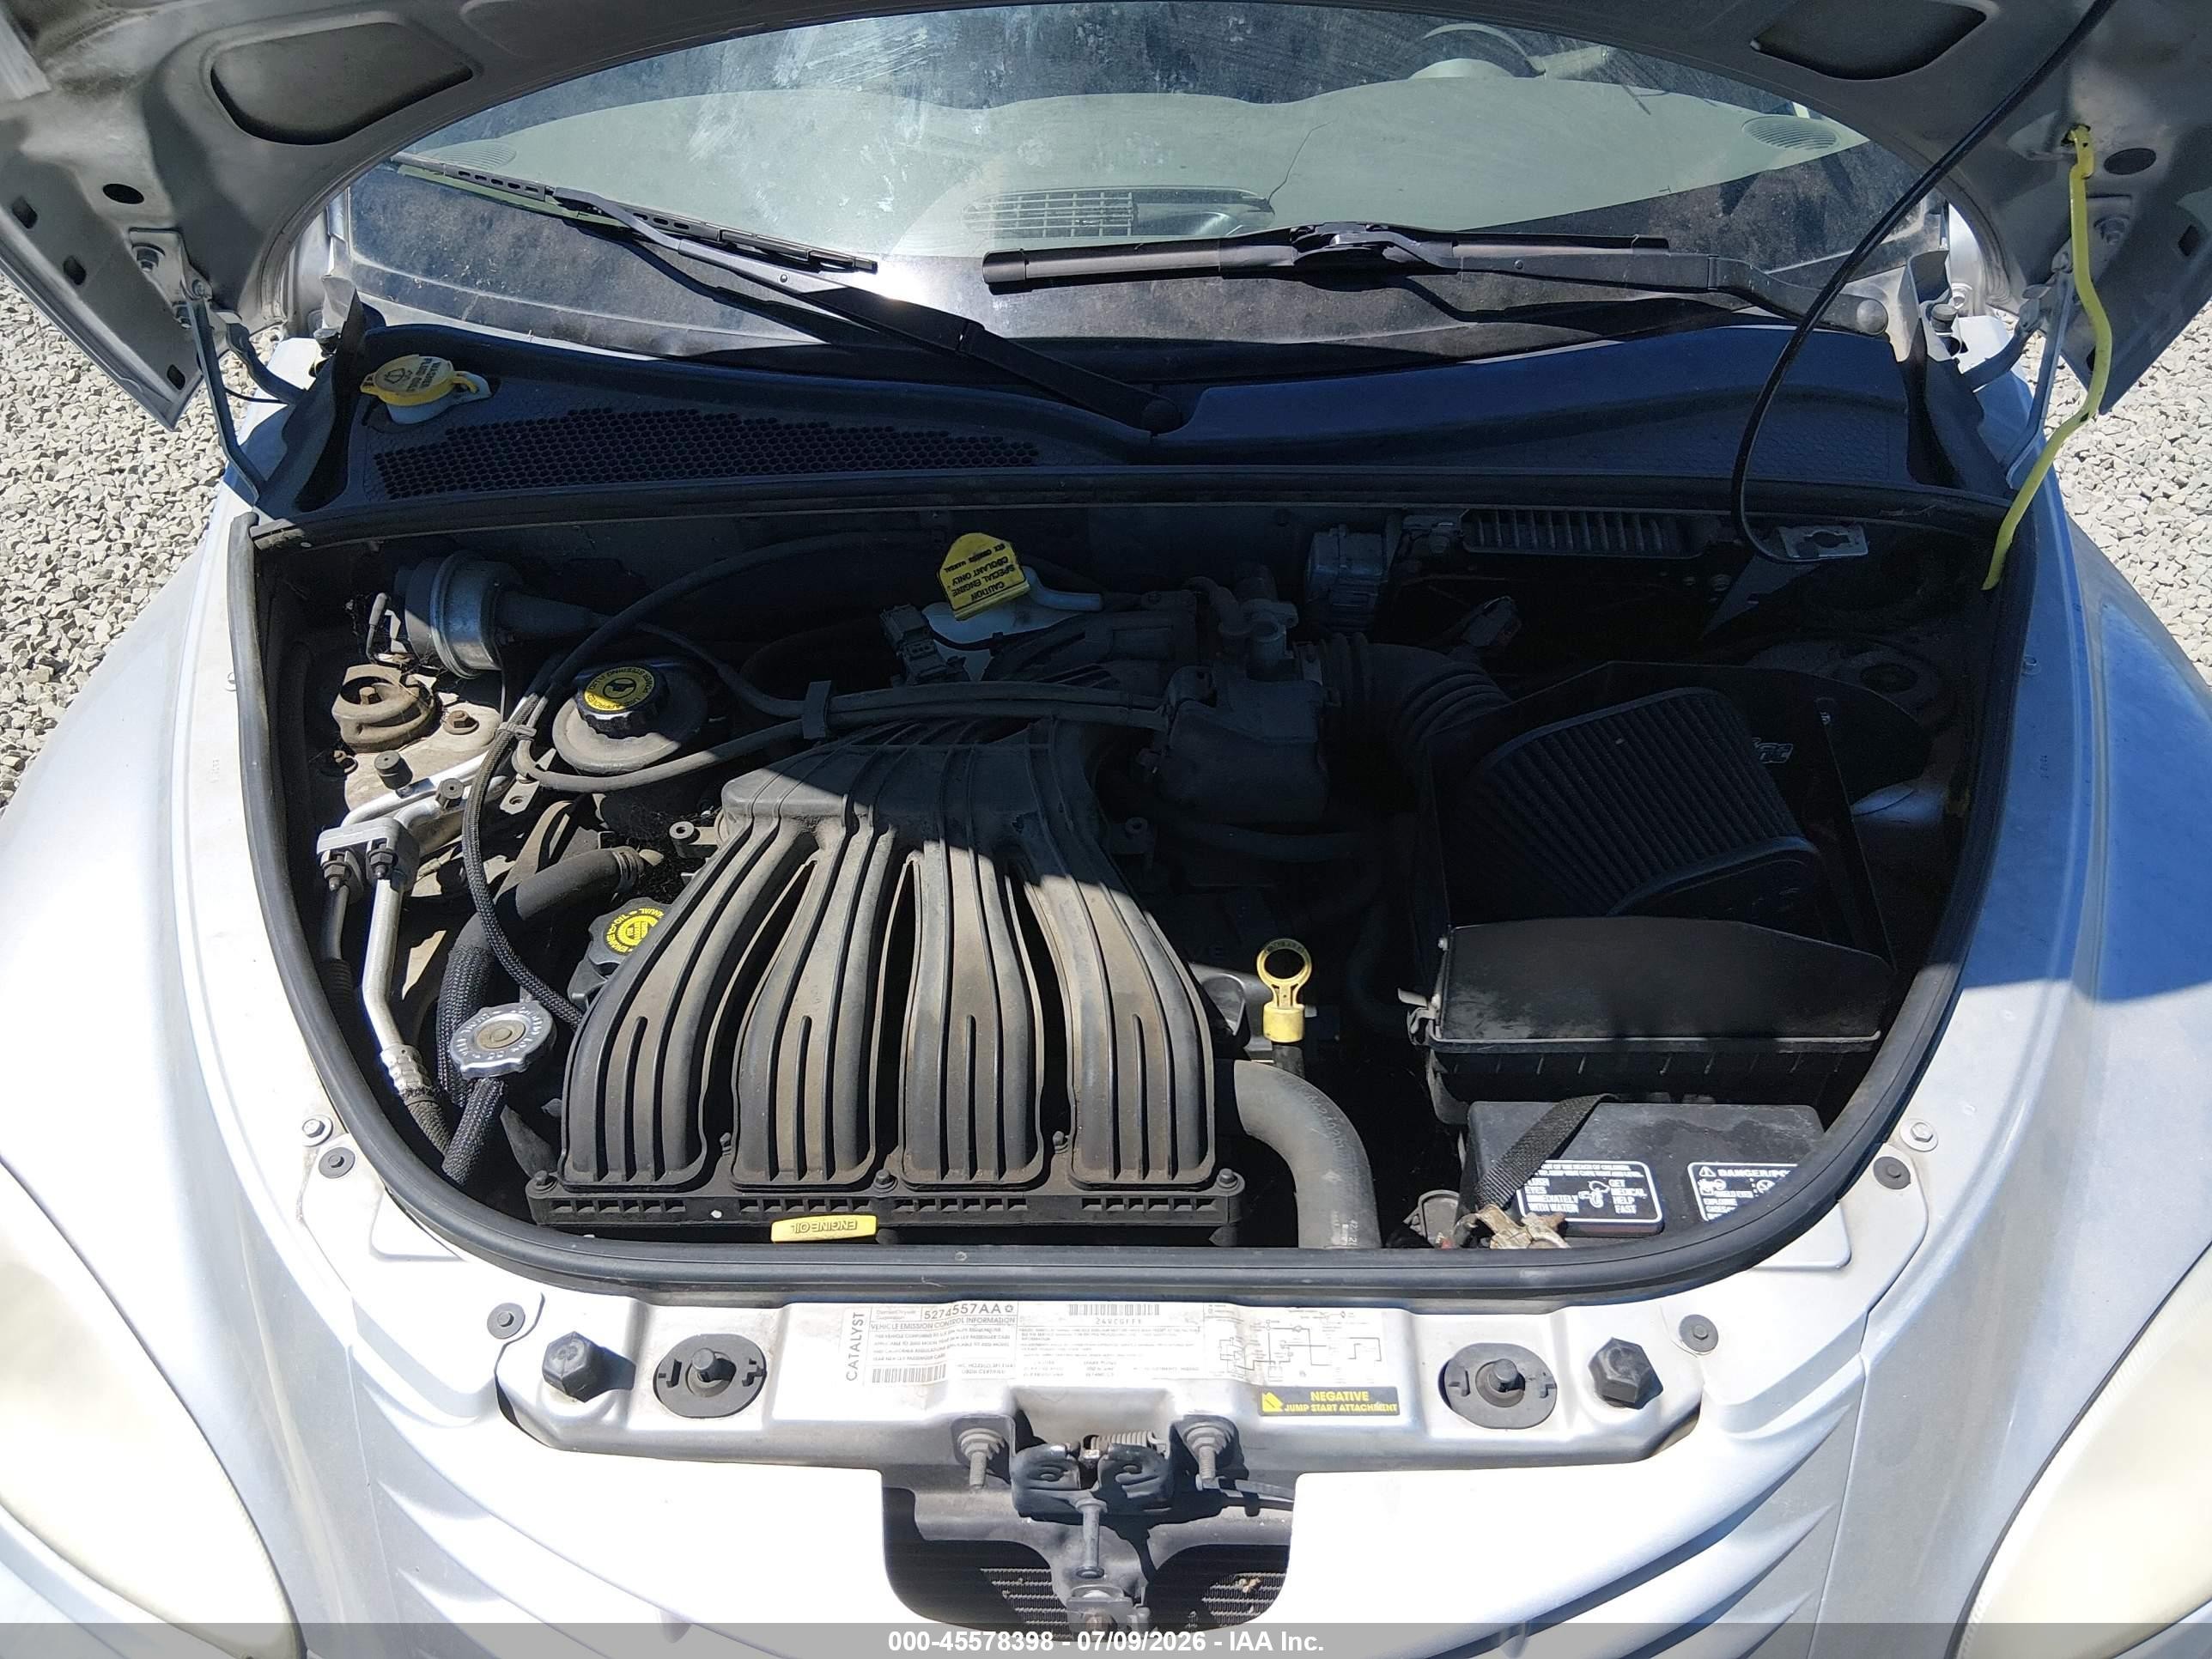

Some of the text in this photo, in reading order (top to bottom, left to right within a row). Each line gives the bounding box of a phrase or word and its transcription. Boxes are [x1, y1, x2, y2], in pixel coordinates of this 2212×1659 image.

[952, 556, 1009, 586] COOLANT ONLY
[951, 564, 1016, 597] SPECIAL ENGINE
[970, 581, 1005, 601] CAUTION
[606, 666, 645, 678] STEERING
[613, 914, 629, 924] OIL
[606, 933, 629, 952] ENGINE
[1608, 1179, 1626, 1188] GET
[1524, 1186, 1547, 1194] EYES
[1611, 1188, 1646, 1197] MEDICAL
[1526, 1194, 1579, 1203] IMMEDIATELY
[1549, 1203, 1579, 1213] WATER
[1614, 1205, 1637, 1214] FAST
[791, 1220, 857, 1233] ENGINE OIL
[924, 1304, 1002, 1320] 5274557AA
[871, 1322, 899, 1331] VEHICLE
[934, 1317, 963, 1329] CONTROL
[846, 1312, 865, 1382] CATALYST
[1310, 1391, 1369, 1401] NEGATIVE
[1285, 1403, 1398, 1413] JUMP START ATTACHMENT
